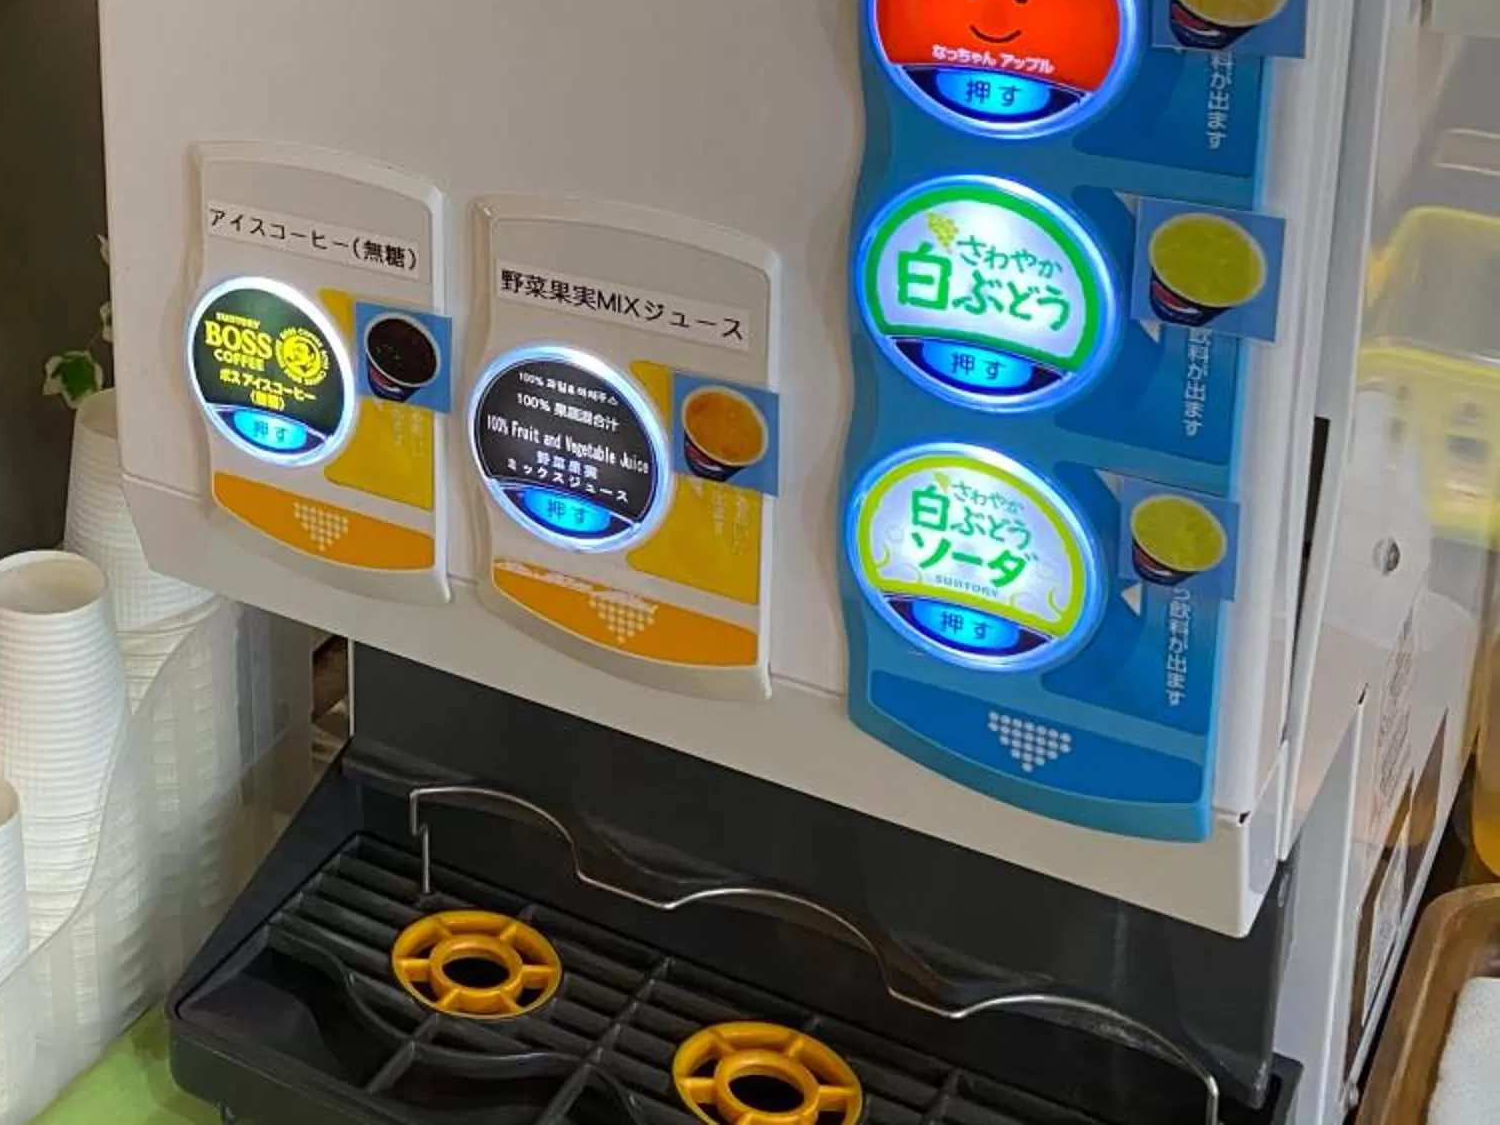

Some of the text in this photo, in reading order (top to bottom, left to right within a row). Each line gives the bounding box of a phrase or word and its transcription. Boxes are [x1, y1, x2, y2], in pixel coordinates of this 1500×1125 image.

[932, 44, 1055, 74] なっちゃん アップル
[966, 78, 1022, 107] 押す
[957, 235, 1063, 277] さわやか
[897, 241, 1071, 331] 白ぶどう
[500, 268, 743, 341] 野菜果実MIXジュース
[204, 320, 273, 360] BOSS
[213, 348, 265, 371] COFFEE
[950, 352, 1005, 381] 押す
[517, 392, 551, 412] 100%
[253, 420, 288, 442] 押す
[487, 414, 649, 474] 100% Fruit and Vegetable Juice
[507, 458, 629, 503] ミックスジュース
[548, 498, 591, 525] 押す
[952, 480, 1024, 513] さわやか
[911, 485, 1031, 550] 白ぶどう
[911, 532, 1039, 588] ソーダ
[935, 575, 999, 597] SUNTORY
[941, 611, 990, 640] 押す
